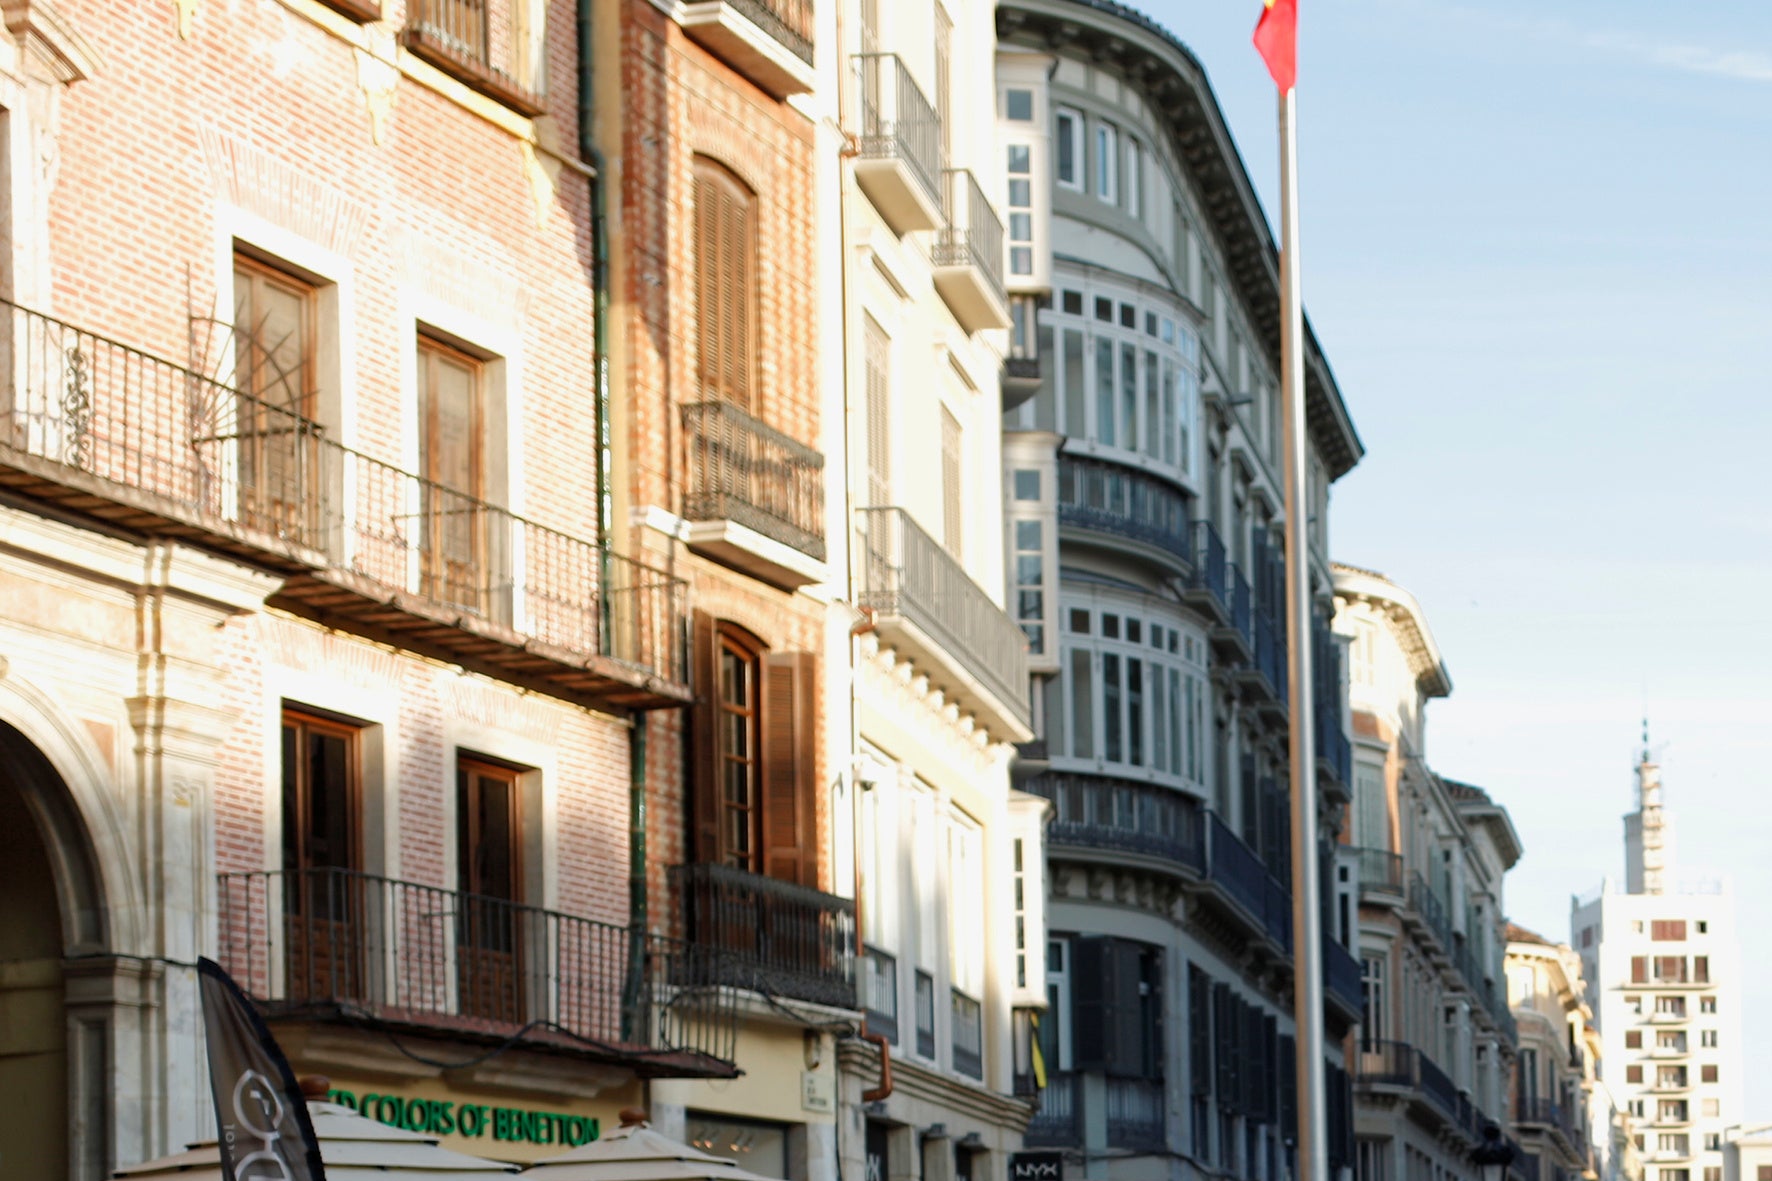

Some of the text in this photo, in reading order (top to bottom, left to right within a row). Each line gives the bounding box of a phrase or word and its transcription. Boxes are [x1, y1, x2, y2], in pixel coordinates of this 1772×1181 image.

[360, 1092, 455, 1134] COLORS
[458, 1103, 489, 1138] OF
[493, 1107, 600, 1147] BENETTON
[1015, 1162, 1058, 1181] NYX
